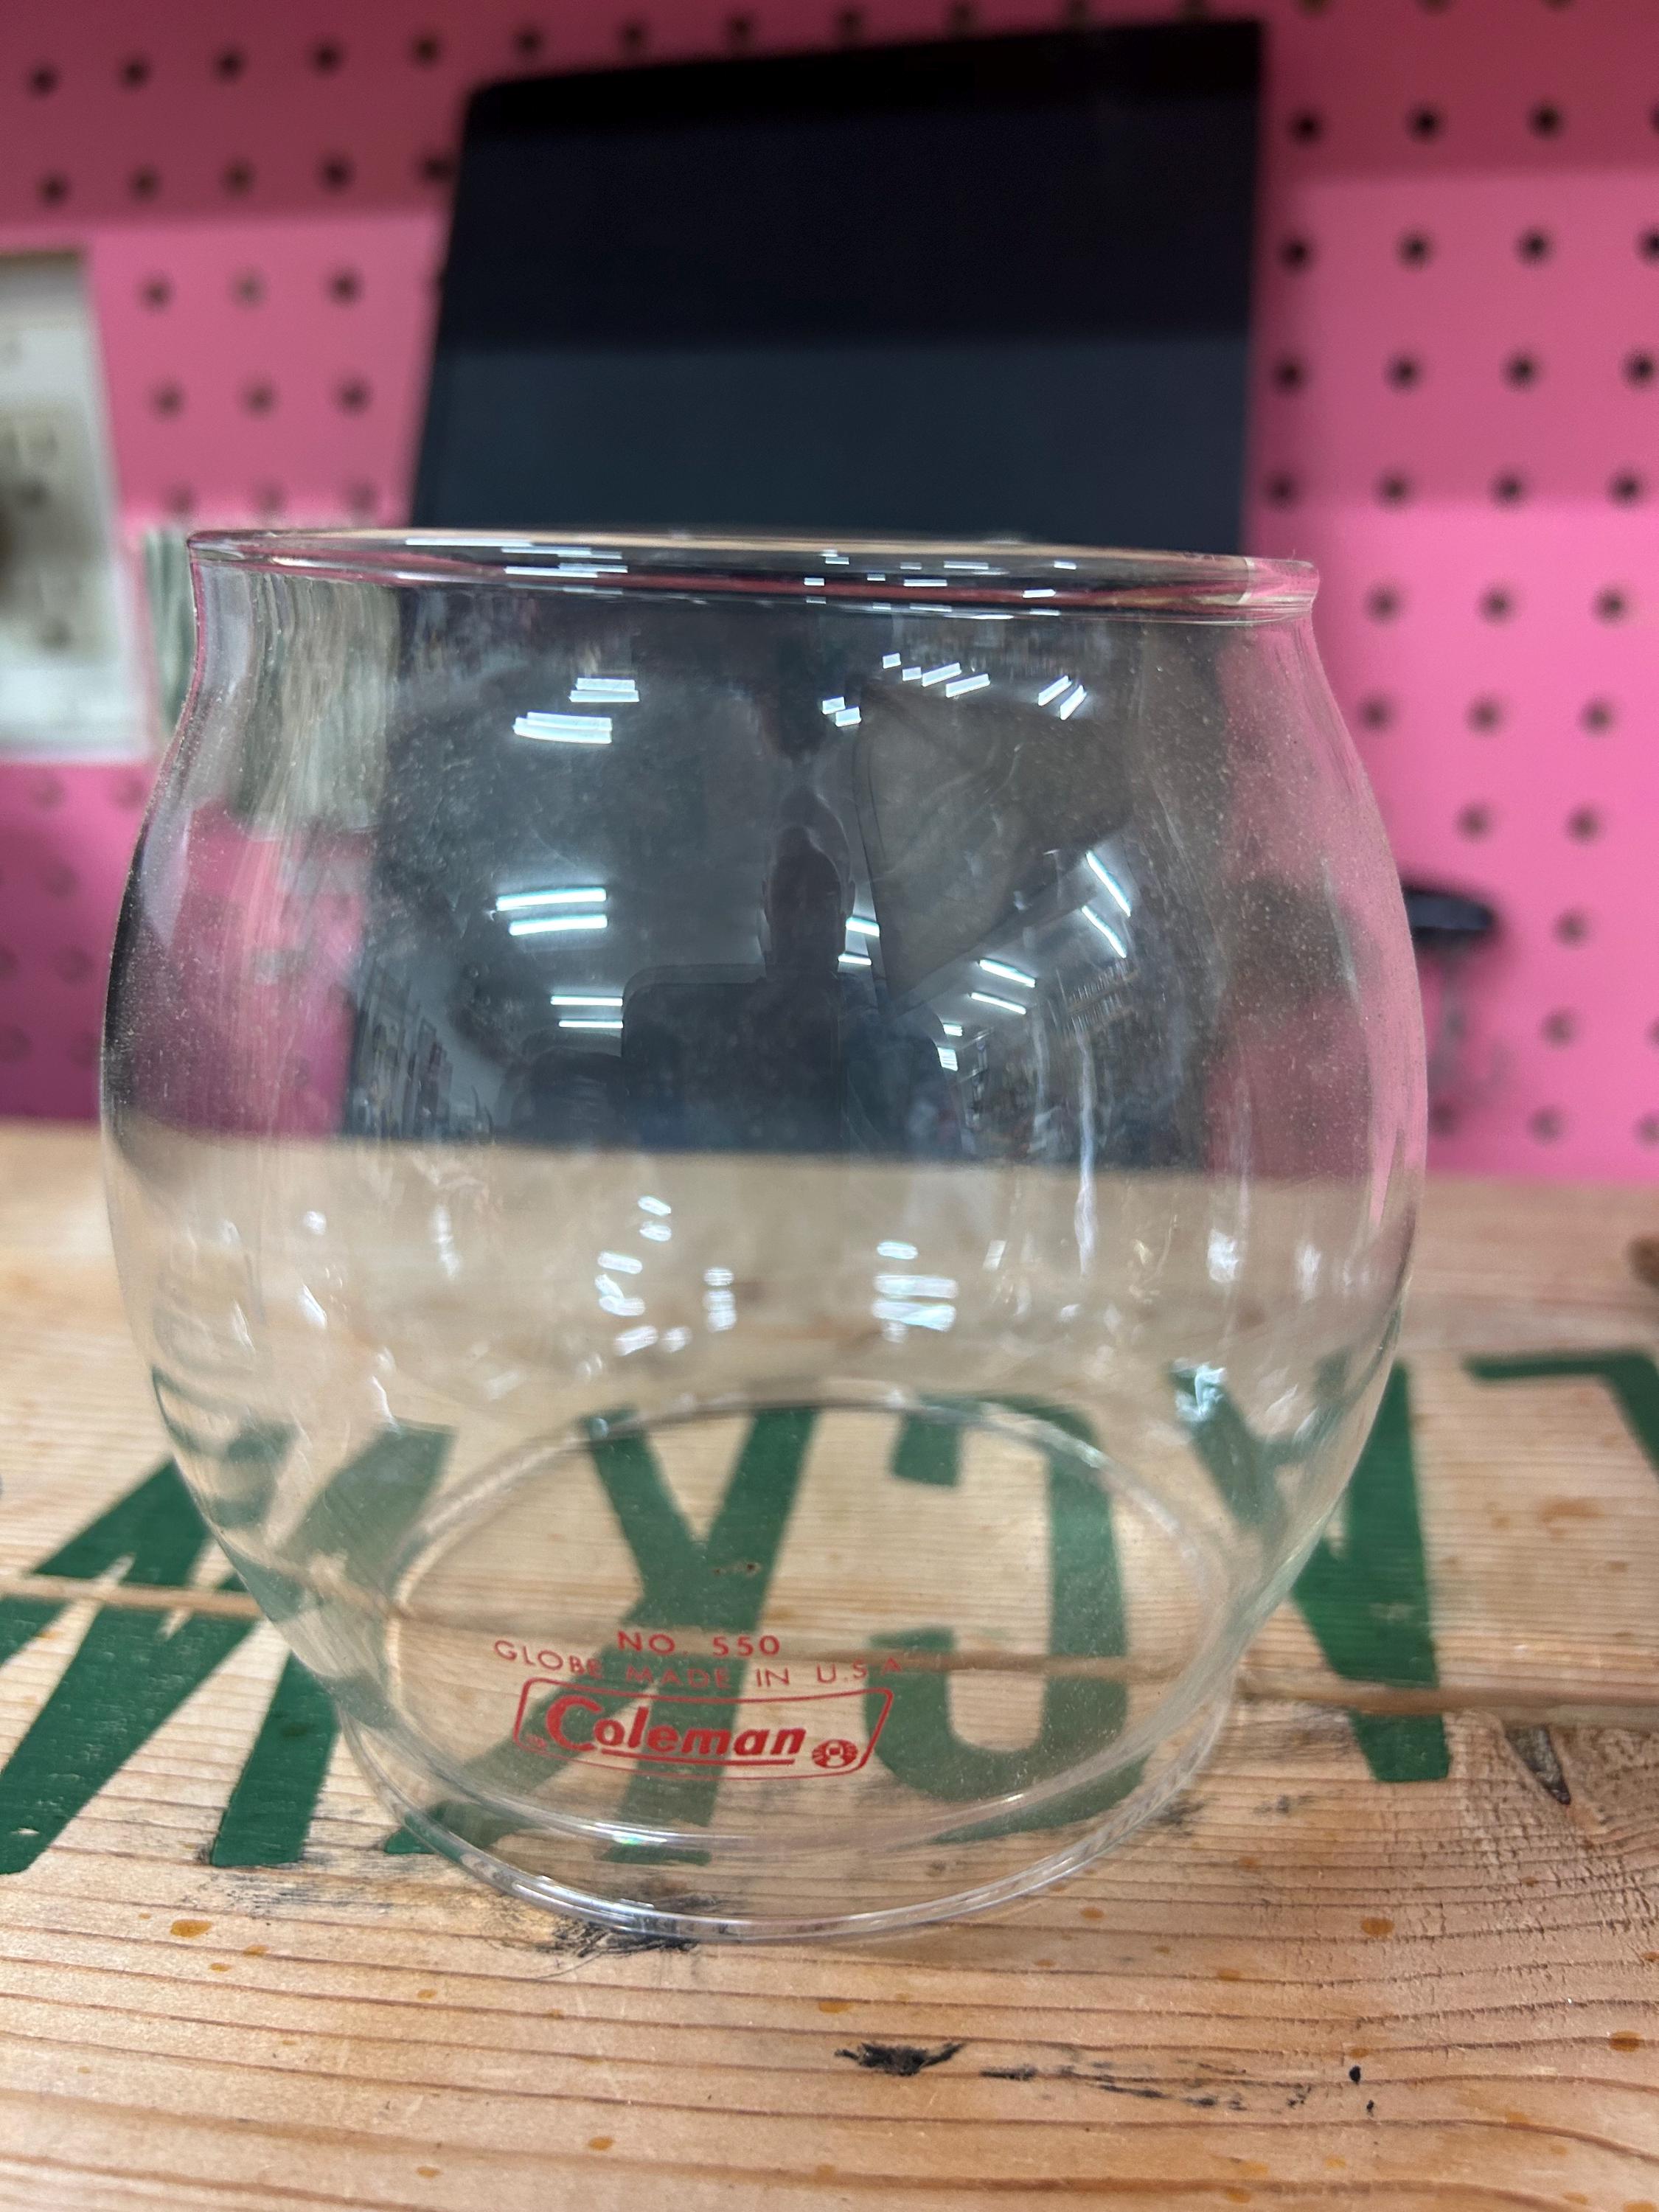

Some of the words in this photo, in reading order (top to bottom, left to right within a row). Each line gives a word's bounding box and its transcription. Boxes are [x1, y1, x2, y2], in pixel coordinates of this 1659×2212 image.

[493, 1640, 602, 1680] GLOBE
[626, 1663, 731, 1689] MADE
[756, 1666, 790, 1687] IN
[617, 1630, 689, 1655] NO.
[712, 1635, 780, 1658] 550
[545, 1694, 807, 1756] Coleman
